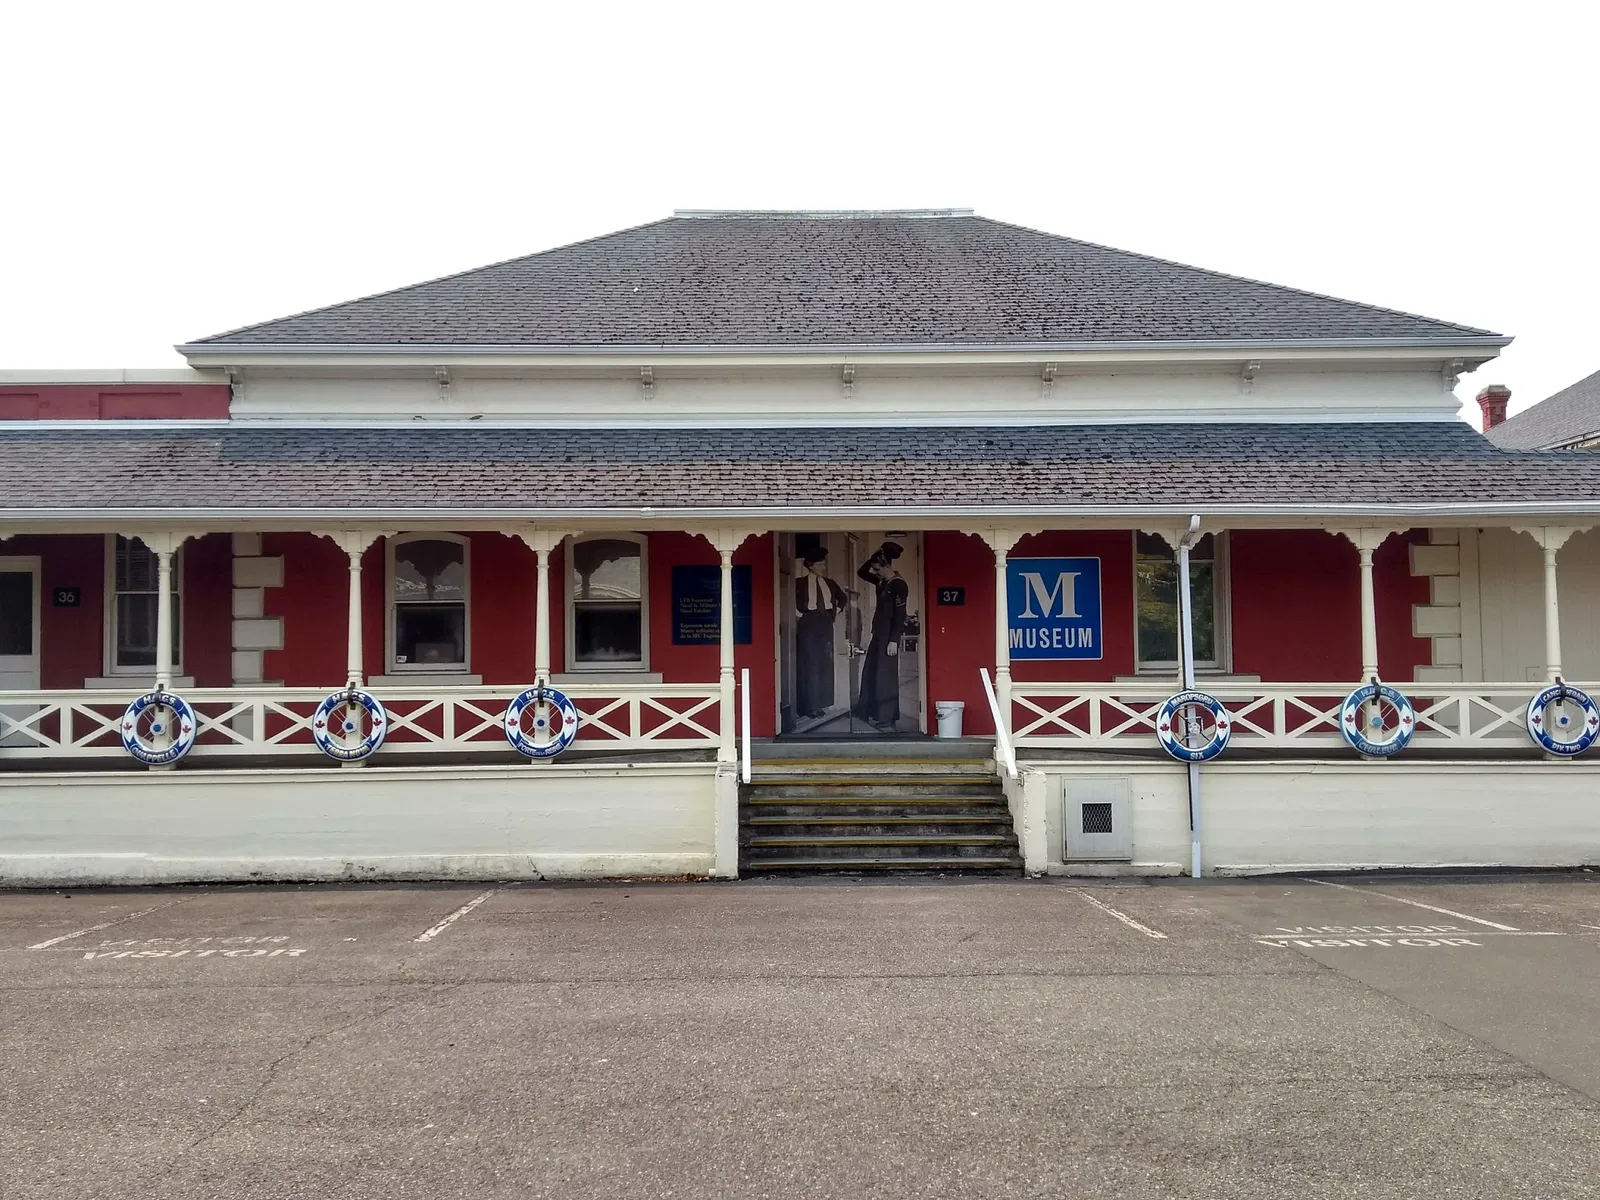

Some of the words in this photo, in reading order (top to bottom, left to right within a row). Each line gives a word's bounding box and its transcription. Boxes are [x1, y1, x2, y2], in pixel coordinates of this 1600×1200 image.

[58, 591, 75, 603] 36
[943, 591, 959, 602] 37
[1017, 572, 1083, 618] M
[1009, 628, 1093, 649] MUSEUM
[349, 745, 370, 758] NOVA
[1358, 742, 1398, 754] CHALEUR
[1565, 744, 1581, 753] TWO
[1190, 752, 1205, 760] SIX
[1276, 925, 1469, 934] VISITOR
[1256, 938, 1484, 947] VISITOR
[83, 949, 308, 960] VISITOR
